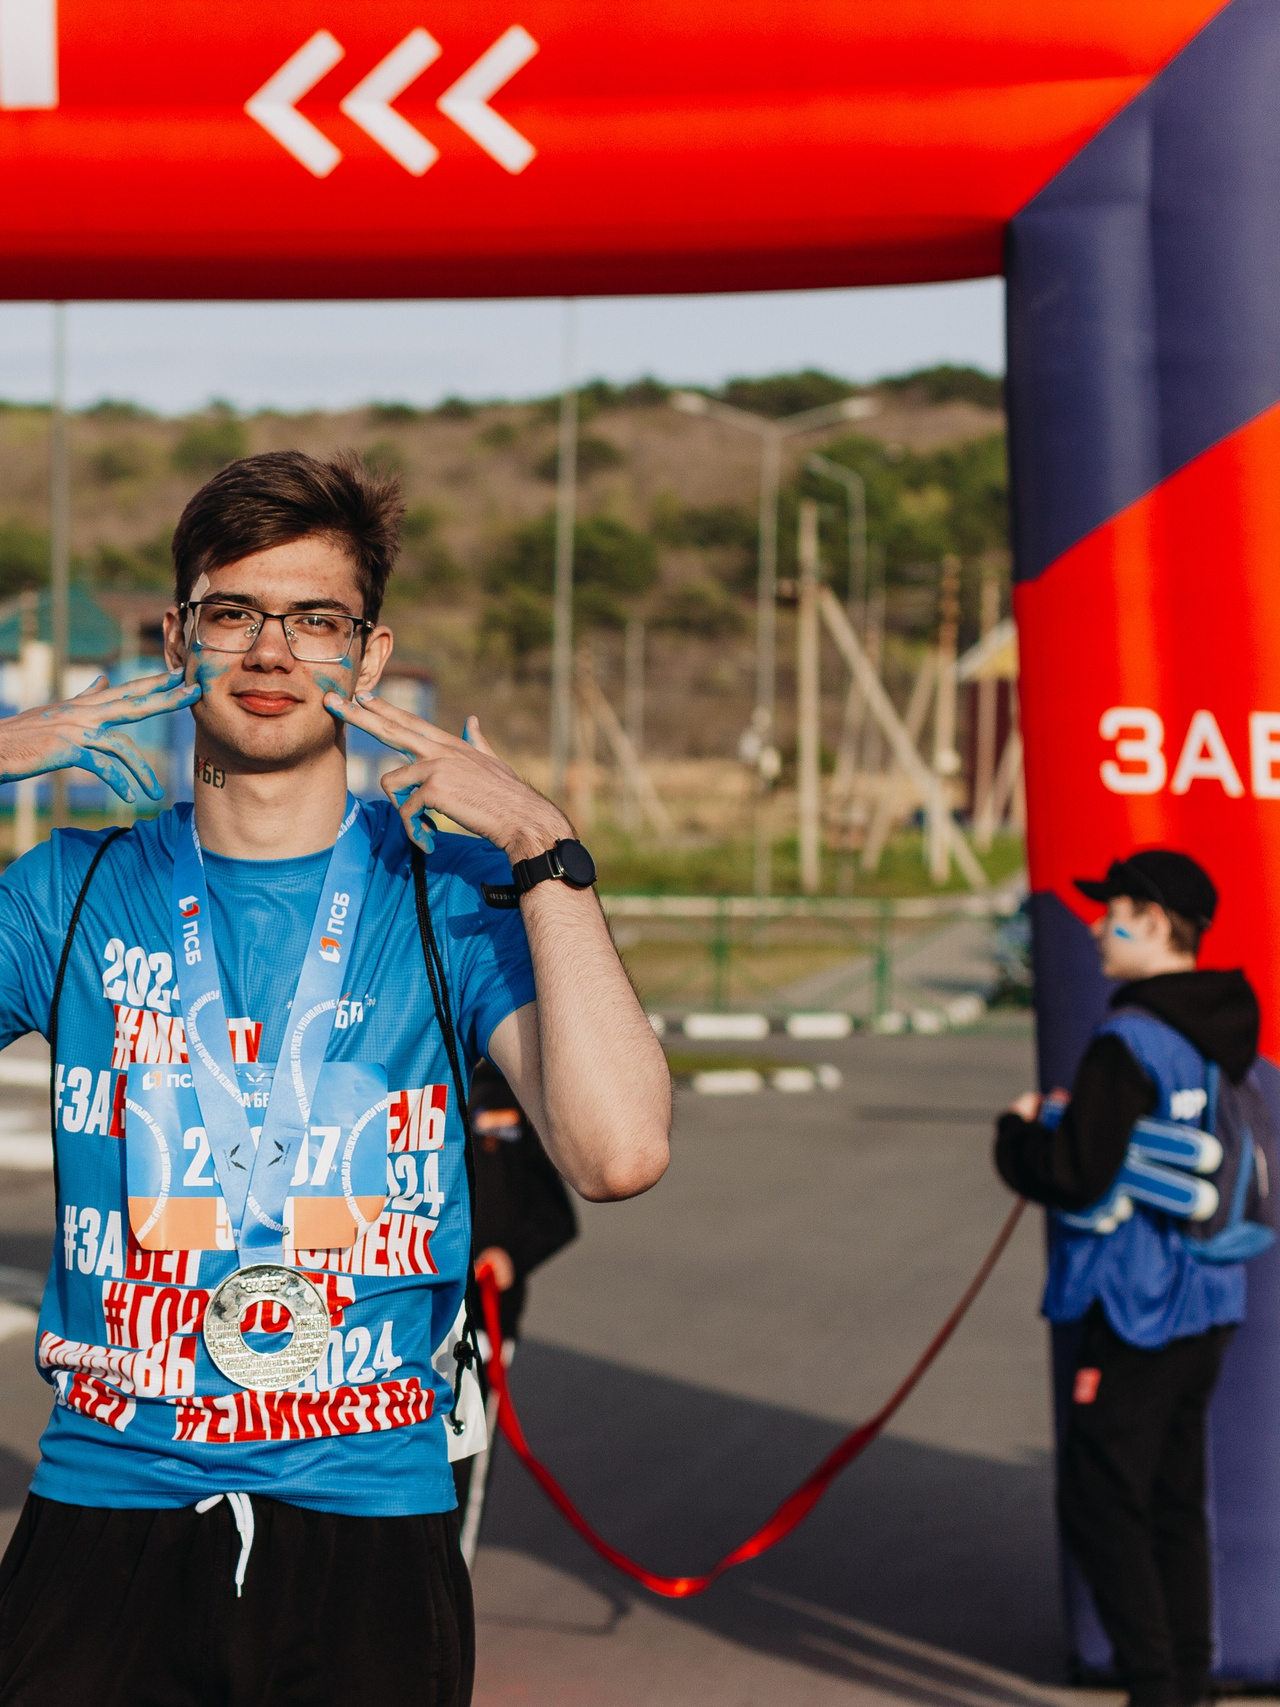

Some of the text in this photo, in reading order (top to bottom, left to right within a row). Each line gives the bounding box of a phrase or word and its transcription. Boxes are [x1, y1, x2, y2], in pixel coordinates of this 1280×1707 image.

[325, 892, 350, 935] ПСБ
[183, 921, 202, 966] ПСБ
[173, 1377, 436, 1443] #ЕДИНСТВО
